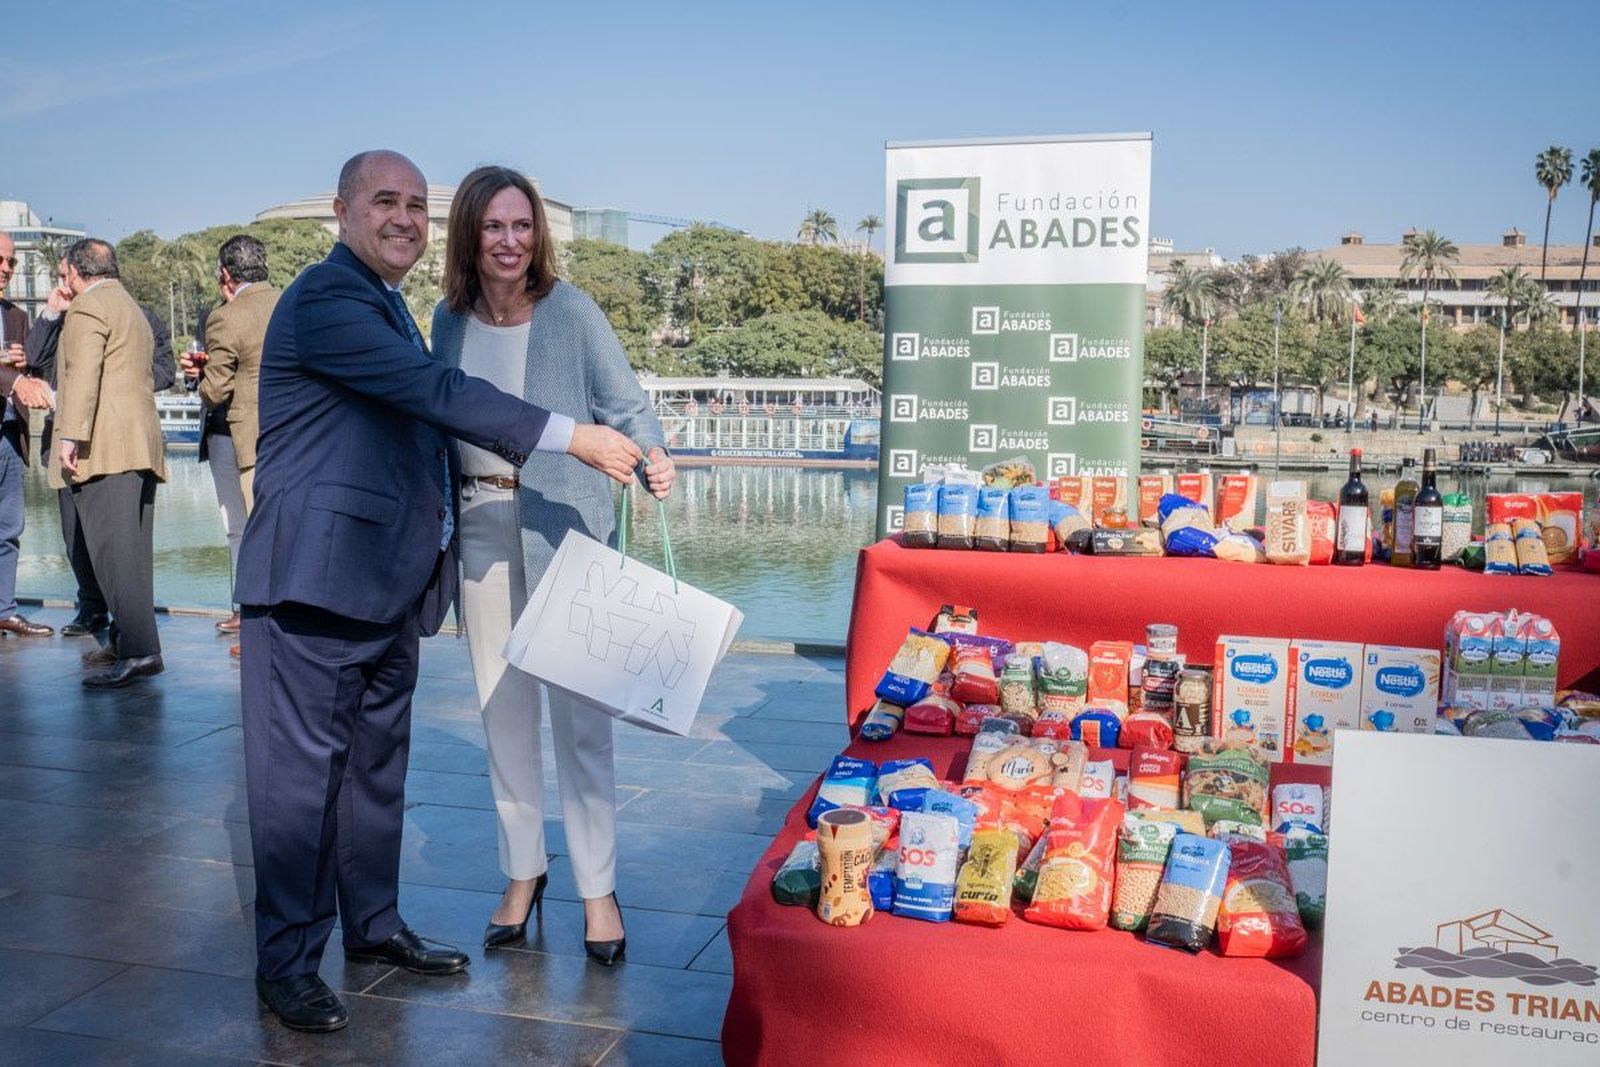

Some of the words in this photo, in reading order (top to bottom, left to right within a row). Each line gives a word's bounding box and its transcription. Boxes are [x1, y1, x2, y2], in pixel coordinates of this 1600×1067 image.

[998, 190, 1138, 212] Fundación
[918, 199, 956, 241] a
[988, 215, 1141, 250] ABADES
[1003, 310, 1050, 319] Fundación
[1001, 320, 1051, 331] ABADES
[924, 336, 970, 346] Fundación
[1082, 337, 1130, 346] Fundación
[921, 346, 971, 358] ABADES
[1079, 347, 1130, 359] ABADES
[1003, 366, 1050, 375] Fundación
[1001, 375, 1051, 387] ABADES
[922, 399, 968, 408] Fundación
[1080, 400, 1128, 410] Fundación
[919, 408, 969, 419] ABADES
[1078, 410, 1129, 422] ABADES
[1001, 428, 1048, 438] Fundación
[999, 438, 1049, 450] ABADES
[921, 454, 967, 463] Fundación
[1079, 458, 1127, 468] Fundación
[1093, 656, 1123, 665] Orlando
[1235, 661, 1272, 674] Nestlé
[1309, 666, 1346, 678] Nestlé
[1381, 673, 1419, 687] Nestlé
[1414, 717, 1428, 726] 0%
[1082, 776, 1105, 791] OS
[1279, 801, 1315, 815] SOS
[900, 847, 937, 866] SOS
[844, 850, 854, 894] TEMPTATION
[1364, 980, 1496, 1013] ABADES
[1506, 992, 1600, 1024] TRIAN
[1361, 1009, 1435, 1028] centro
[1444, 1015, 1471, 1031] de
[1481, 1021, 1600, 1045] restaurac
